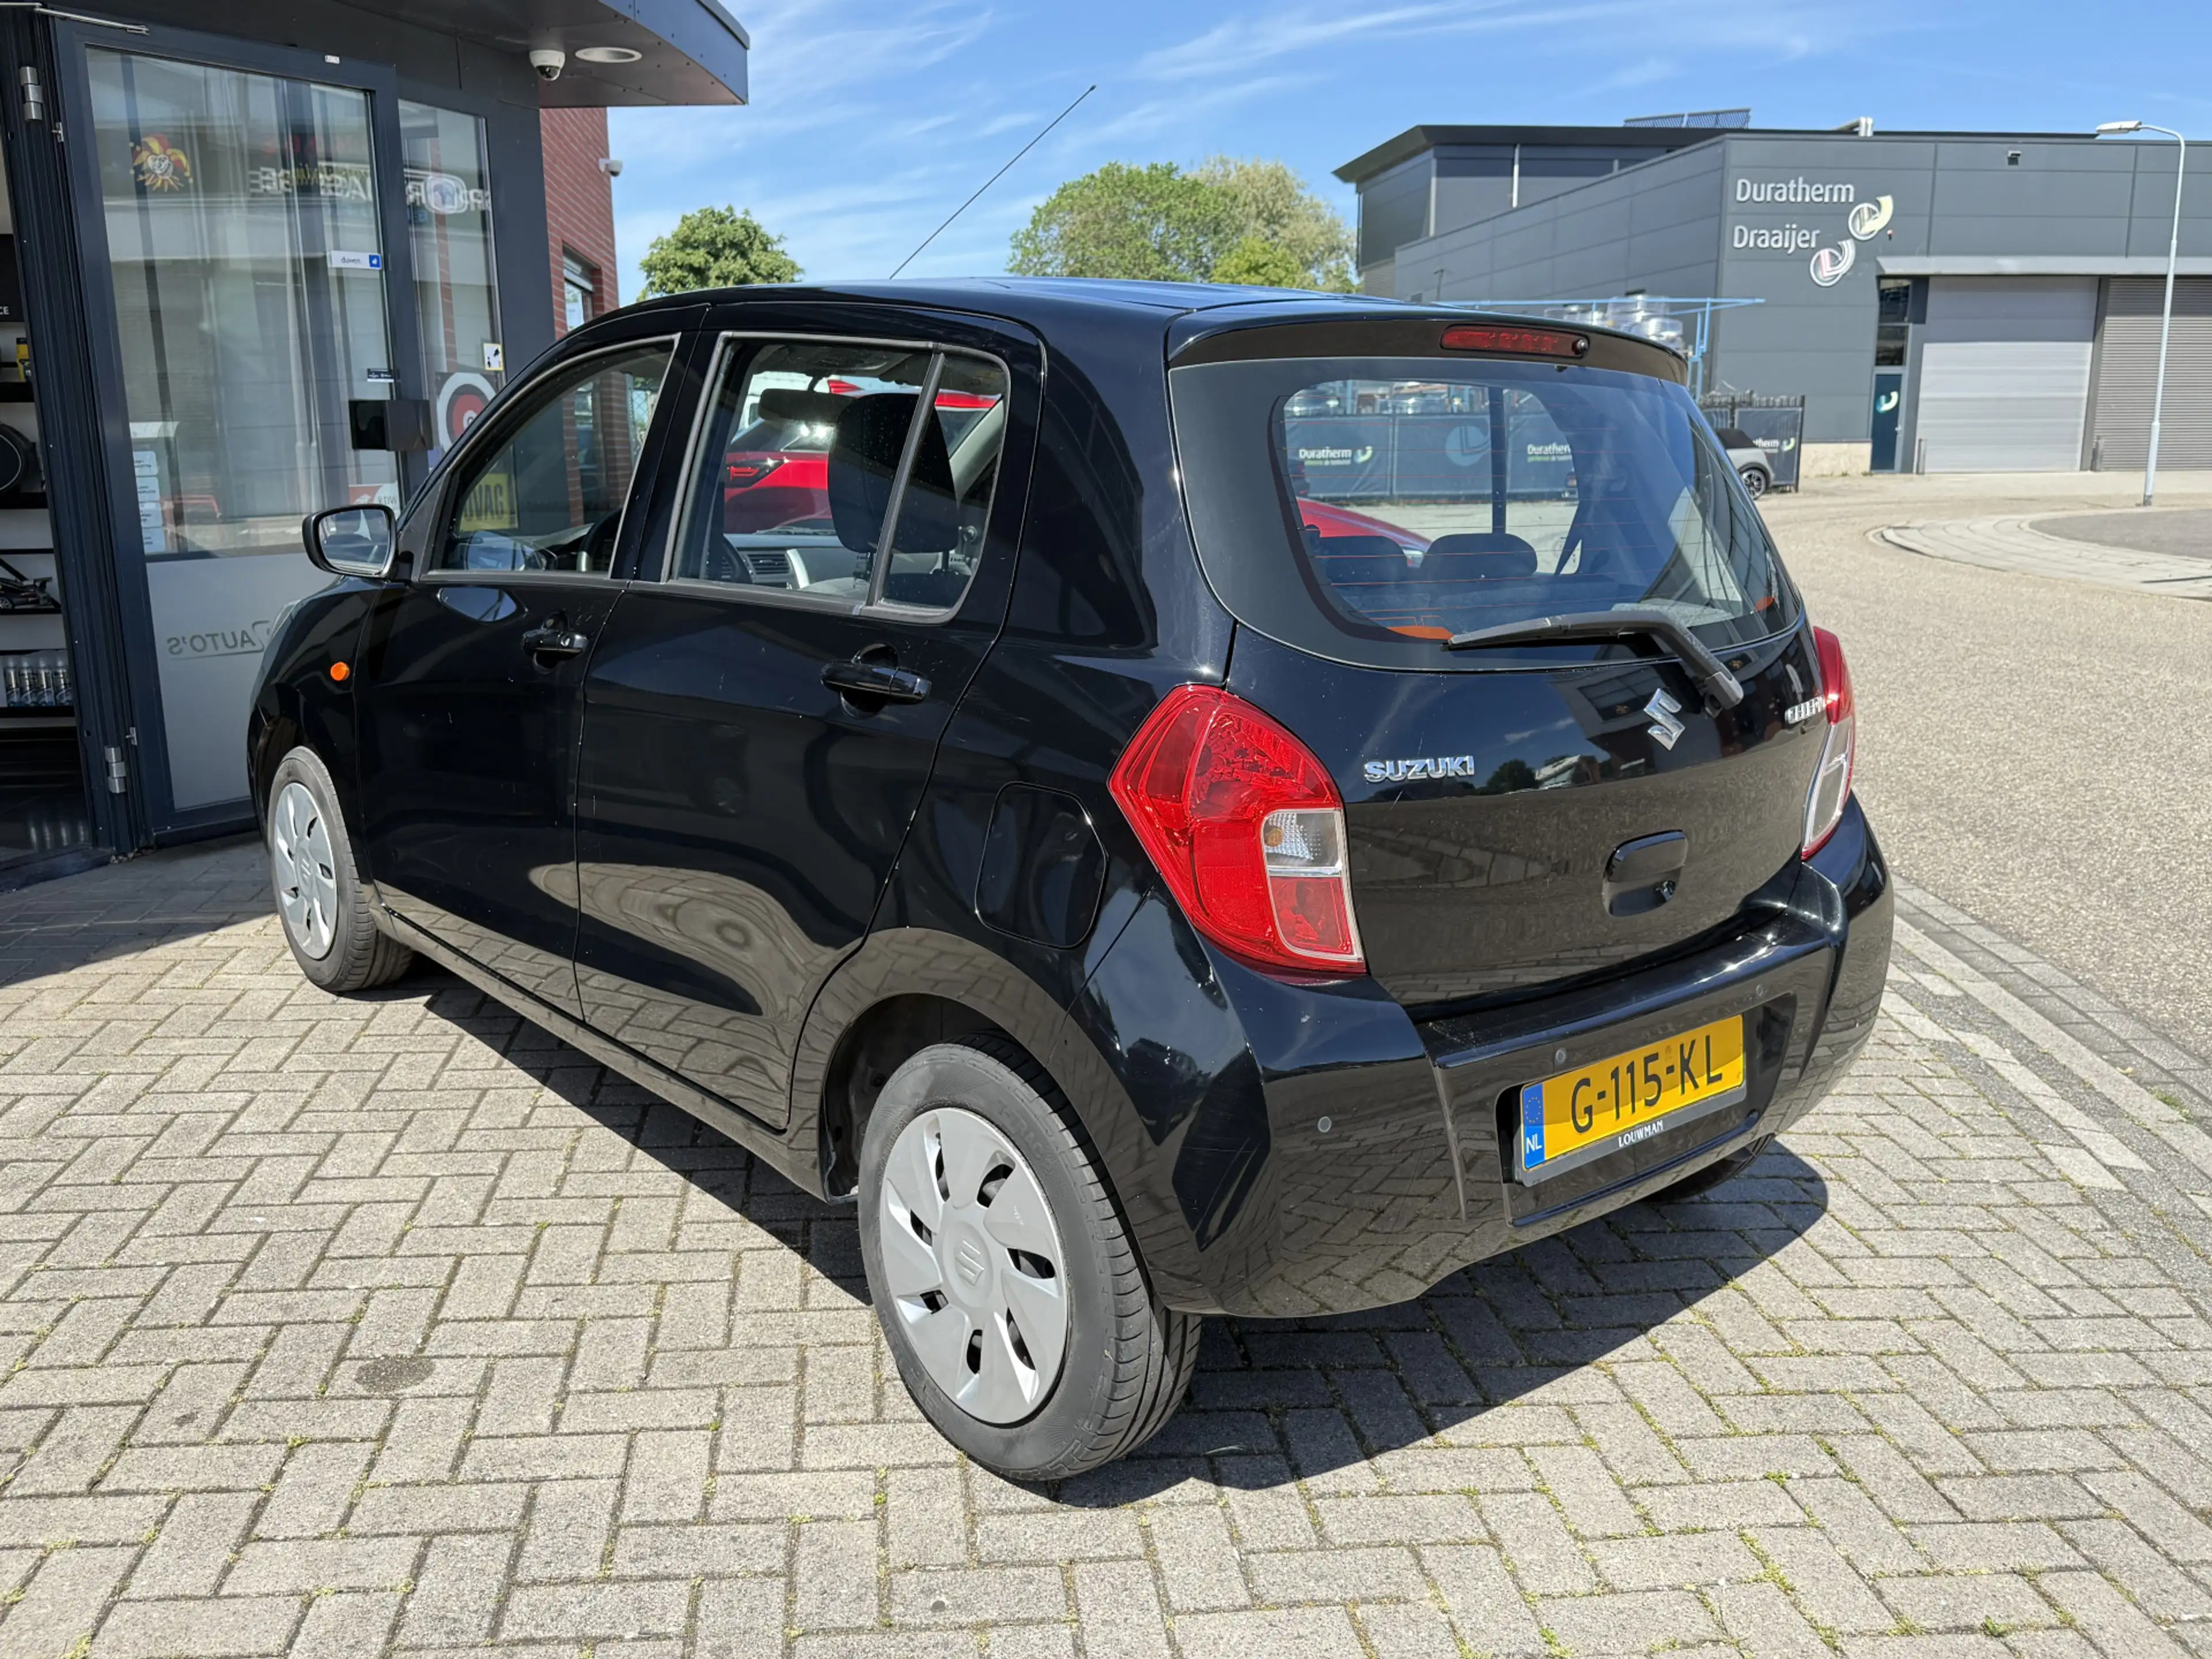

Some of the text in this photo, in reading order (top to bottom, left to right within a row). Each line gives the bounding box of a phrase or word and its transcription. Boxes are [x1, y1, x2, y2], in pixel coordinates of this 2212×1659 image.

[1736, 177, 1854, 203] Duratherm
[1733, 224, 1820, 255] Draaijer
[1298, 446, 1352, 459] Duratherm
[1364, 755, 1475, 783] SUZUKI
[1571, 1035, 1722, 1134] G-115-KL
[1525, 1133, 1542, 1154] NL
[1618, 1119, 1664, 1147] LOUWMAN
